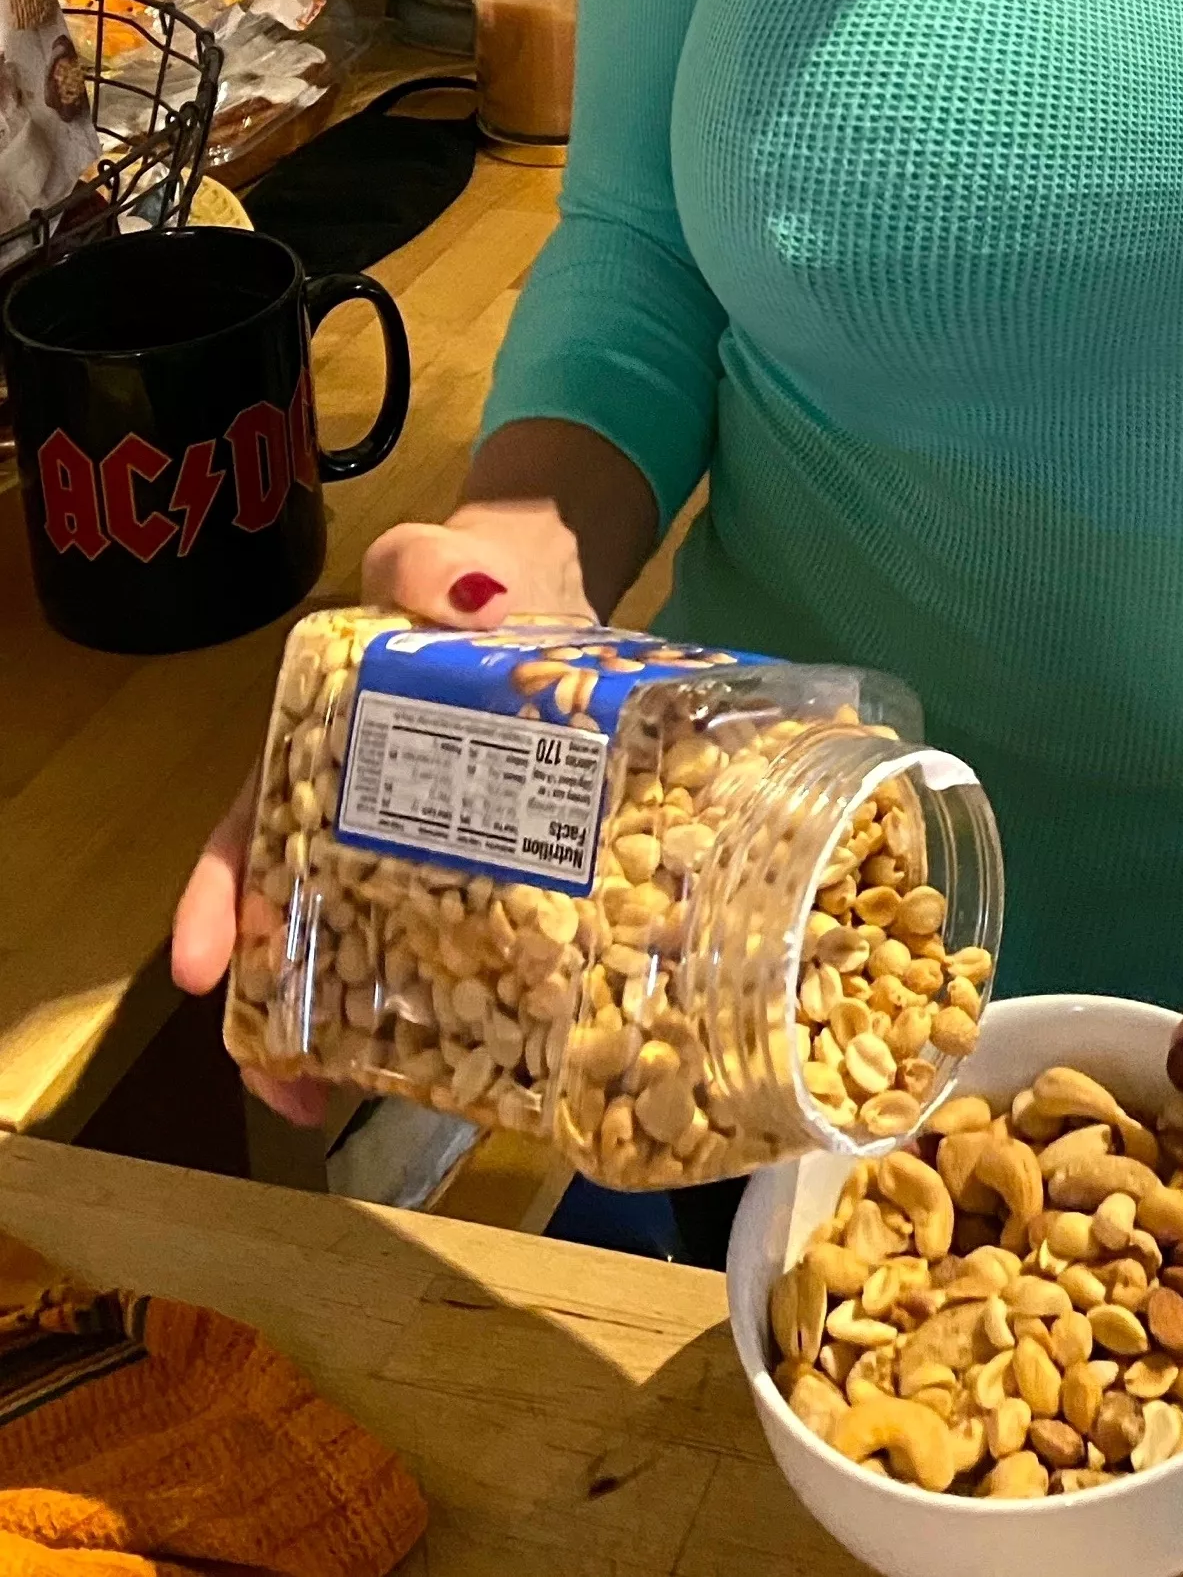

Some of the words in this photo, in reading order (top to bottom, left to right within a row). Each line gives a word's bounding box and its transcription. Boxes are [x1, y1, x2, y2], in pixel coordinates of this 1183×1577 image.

[537, 738, 561, 766] 170
[549, 821, 588, 847] Facts
[523, 837, 584, 870] Nutrition
